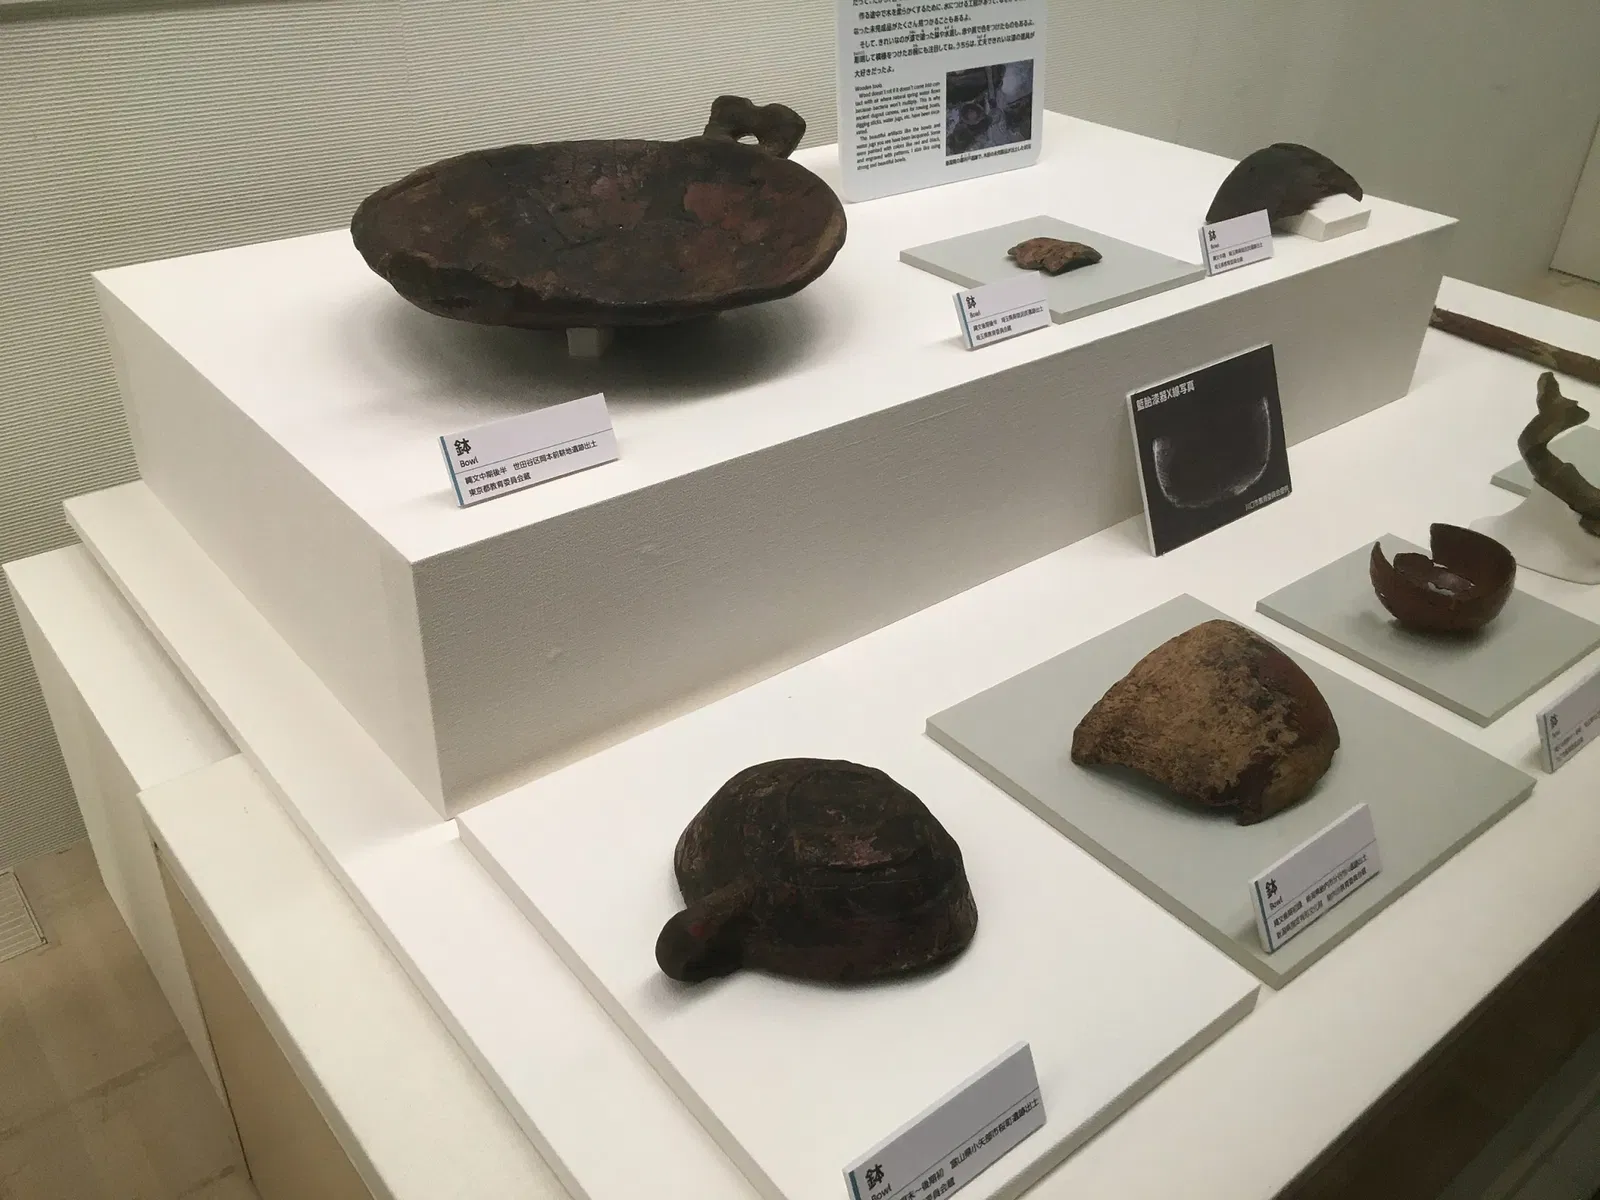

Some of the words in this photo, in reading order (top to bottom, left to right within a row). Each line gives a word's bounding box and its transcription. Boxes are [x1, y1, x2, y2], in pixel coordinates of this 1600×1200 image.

[966, 295, 976, 309] 鉢
[970, 310, 981, 319] Bowl
[454, 438, 472, 456] 鉢
[460, 457, 478, 468] Bowl
[465, 467, 507, 485] 縄文中期後半
[513, 440, 598, 471] 世田谷区岡本前耕地遺跡出土
[469, 473, 531, 497] 東京都教育委員会蔵
[1265, 878, 1278, 899] 鉢
[1269, 896, 1283, 910] Bowl
[865, 1164, 884, 1191] 鉢
[871, 1183, 892, 1200] Bowl
